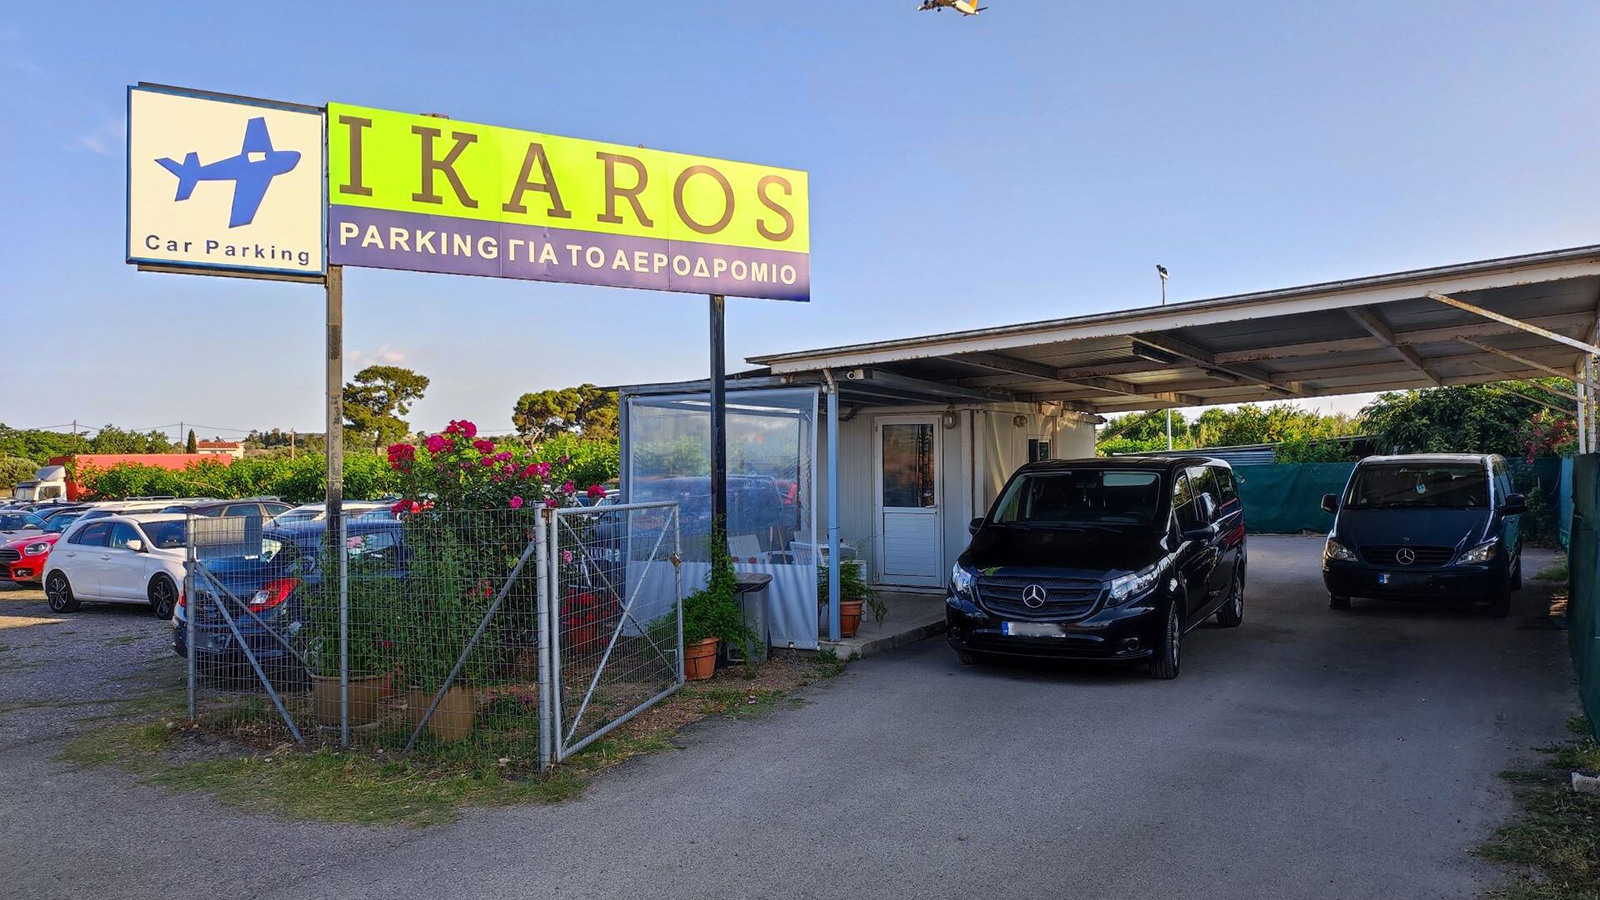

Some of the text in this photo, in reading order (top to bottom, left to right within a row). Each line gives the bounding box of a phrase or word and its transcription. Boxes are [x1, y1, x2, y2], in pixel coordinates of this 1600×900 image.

[339, 115, 795, 242] IKAROS
[145, 234, 310, 266] Car Parking
[340, 222, 797, 285] PARKING ΓΙΑ ΤΟ ΑΕΡΟΔΡΟΜΙΟ
